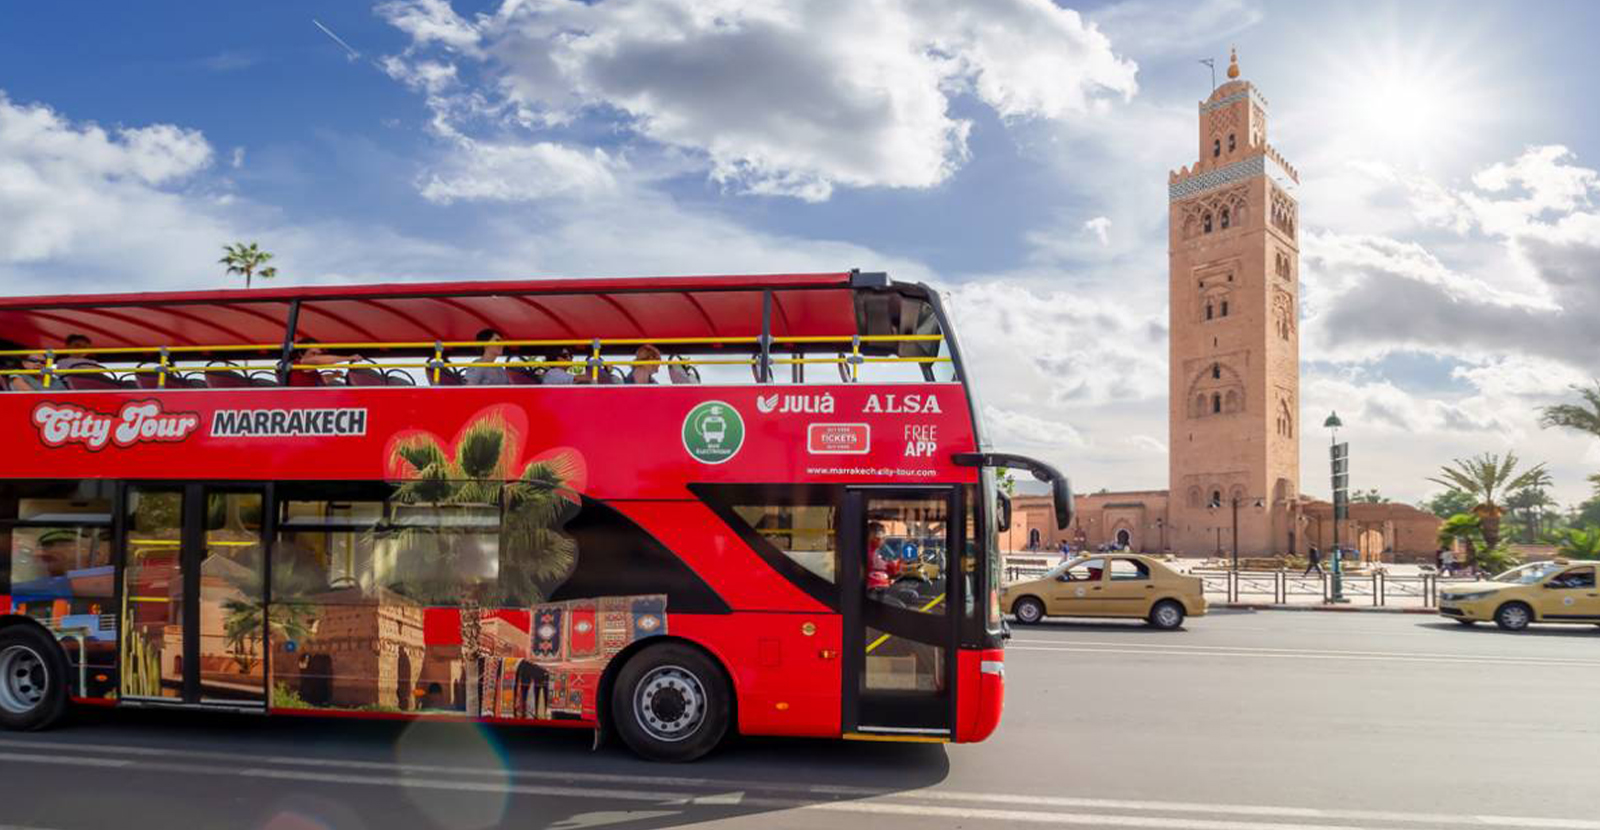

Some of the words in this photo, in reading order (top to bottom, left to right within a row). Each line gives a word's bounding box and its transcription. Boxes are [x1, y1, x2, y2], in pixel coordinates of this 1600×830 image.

[862, 394, 942, 414] ALSA
[35, 406, 111, 446] City
[115, 404, 196, 442] Tour
[212, 409, 366, 436] MARRAKECH
[904, 425, 938, 441] FREE
[904, 441, 938, 457] APP
